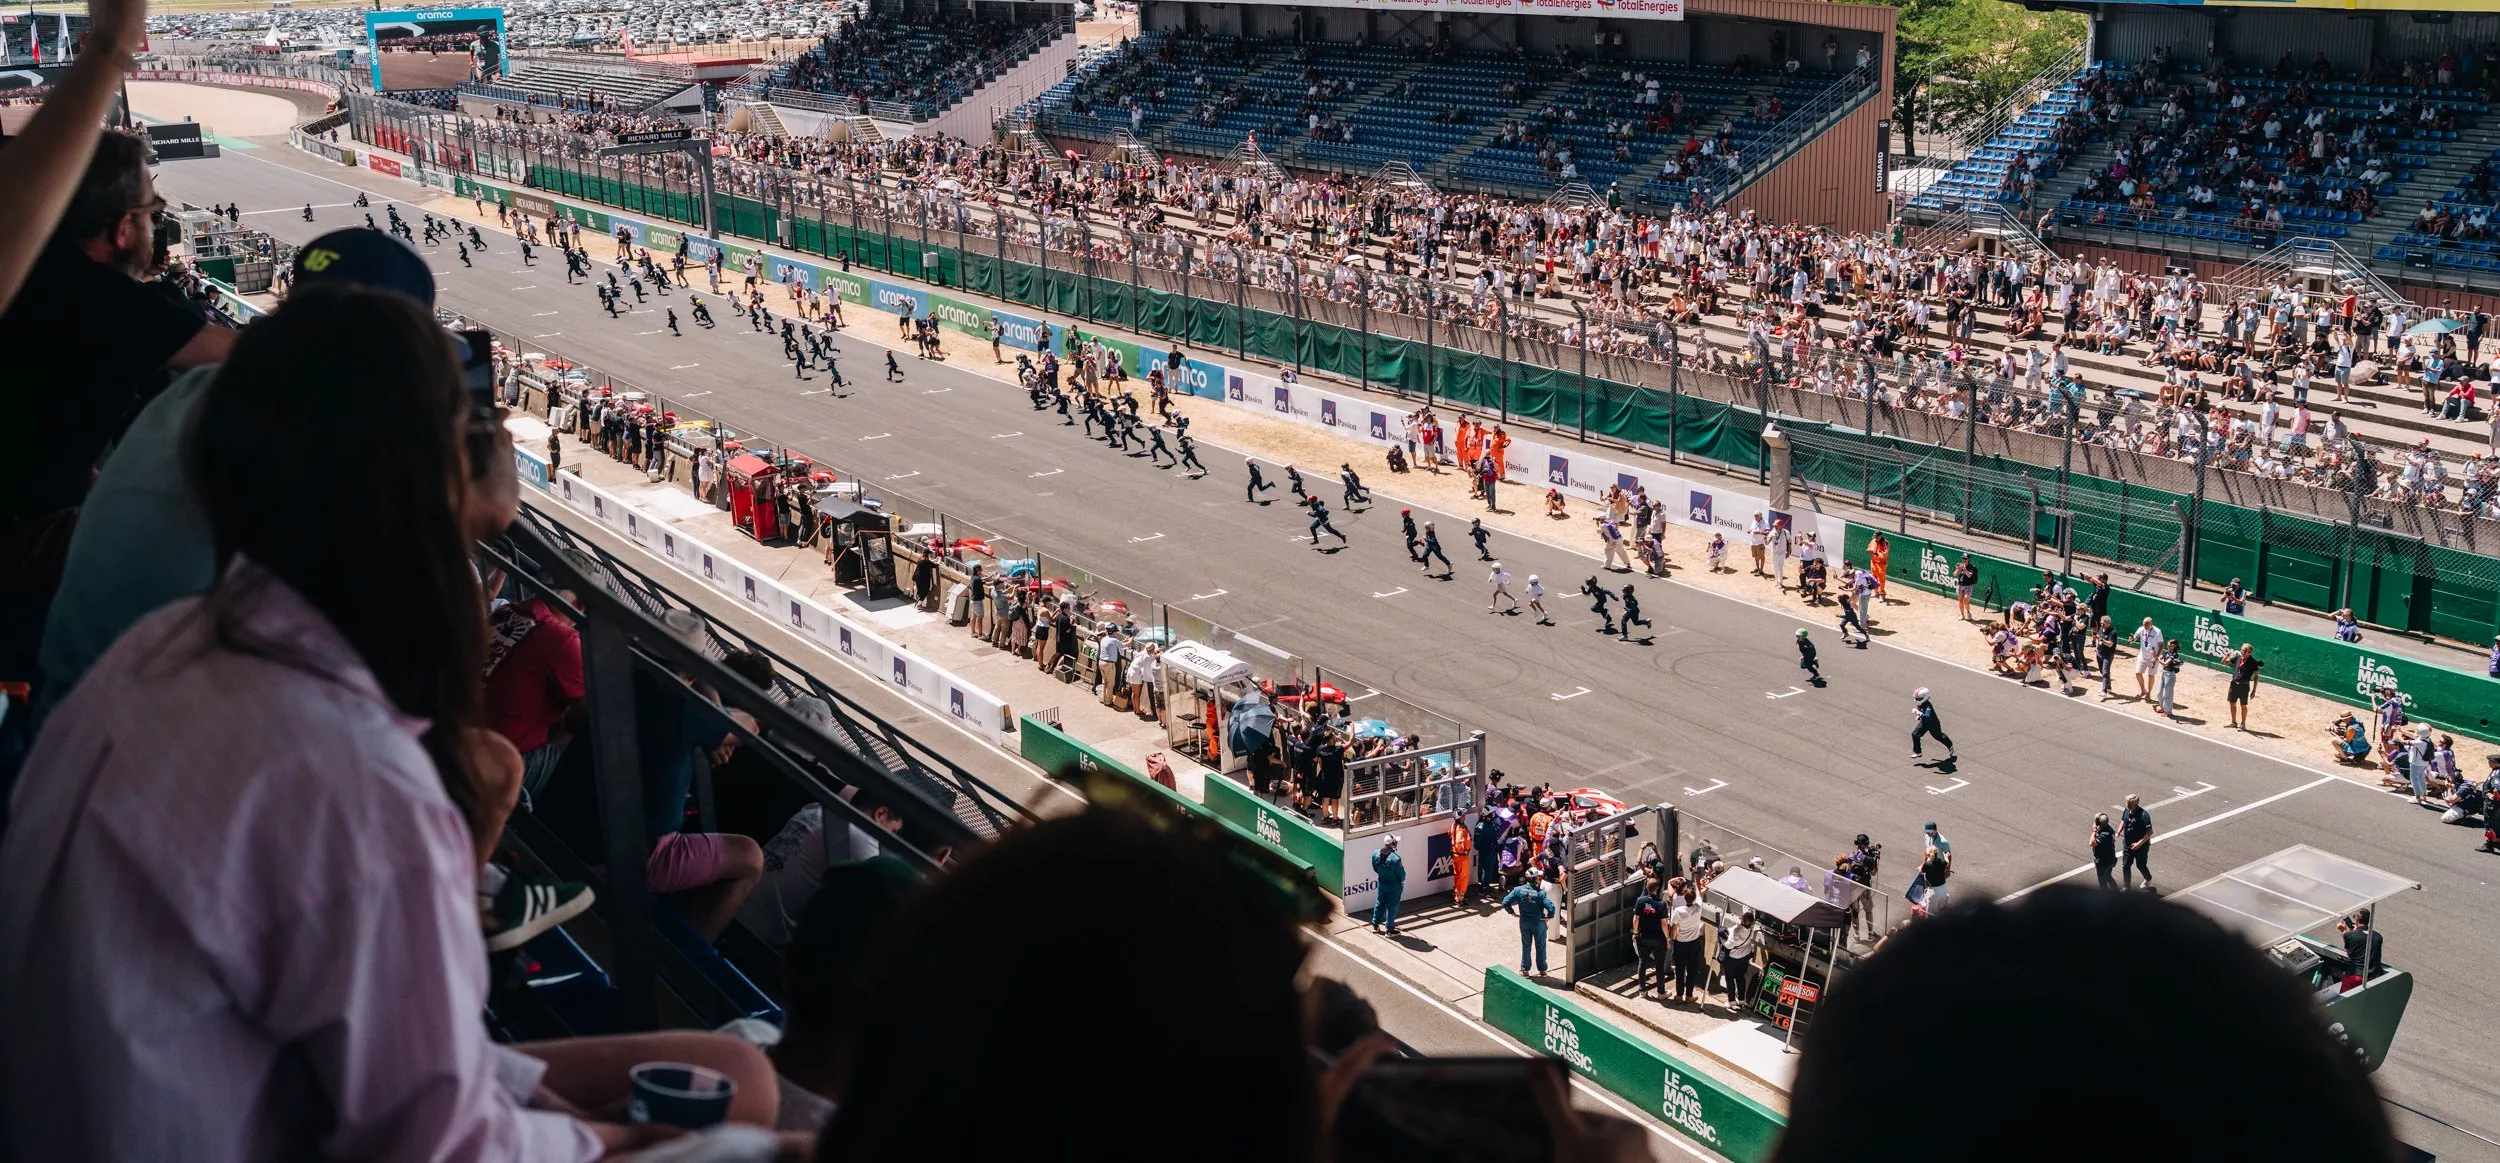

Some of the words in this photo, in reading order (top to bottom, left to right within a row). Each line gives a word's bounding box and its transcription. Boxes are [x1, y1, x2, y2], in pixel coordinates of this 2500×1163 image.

[416, 11, 454, 20] aramco
[1617, 2, 1679, 15] TotalEnergies
[368, 38, 378, 66] aramco
[499, 32, 507, 60] aramco
[136, 71, 156, 80] MOTUL
[159, 71, 177, 80] MOTUL
[627, 133, 658, 142] RICHARD
[660, 131, 683, 139] MILLE
[1876, 151, 1884, 192] LEONARD
[515, 197, 533, 210] RICHARD
[533, 202, 549, 215] MILLE
[651, 231, 677, 247] aramco
[826, 275, 861, 297] aramco
[938, 302, 979, 328] aramco
[1230, 387, 1242, 400] AXA
[1244, 392, 1263, 405] Passion
[1274, 399, 1288, 413] AXA
[1290, 405, 1309, 418] Passion
[1321, 411, 1336, 426] AXA
[1338, 418, 1357, 431] Passion
[1371, 425, 1383, 438] AXA
[1505, 460, 1529, 475] Passion
[1549, 469, 1564, 486] AXA
[1570, 477, 1596, 493] Passion
[1690, 507, 1708, 522] AXA
[1714, 515, 1743, 531] Passion
[1922, 548, 1934, 559] LE
[1921, 560, 1950, 576] MANS
[2195, 615, 2209, 629] LE
[2194, 627, 2229, 647] MANS
[2359, 656, 2375, 671] LE
[894, 671, 904, 686] AXA
[908, 679, 922, 694] Passion
[2358, 667, 2398, 690] MANS
[951, 702, 963, 718] AXA
[966, 711, 982, 728] Passion
[1080, 752, 1088, 765] LE
[1257, 807, 1268, 824] LE
[1256, 822, 1281, 844] MANS
[1758, 1001, 1771, 1015] T4
[1779, 993, 1795, 1006] P9
[1545, 1004, 1560, 1025] LE
[1775, 1015, 1782, 1025] T
[1782, 1018, 1790, 1029] 6
[1545, 1018, 1580, 1050] MANS
[1544, 1035, 1593, 1073] CLASSIC
[1664, 1068, 1680, 1091] LE
[1664, 1083, 1702, 1119] MANS
[1663, 1101, 1717, 1144] CLASSIC
